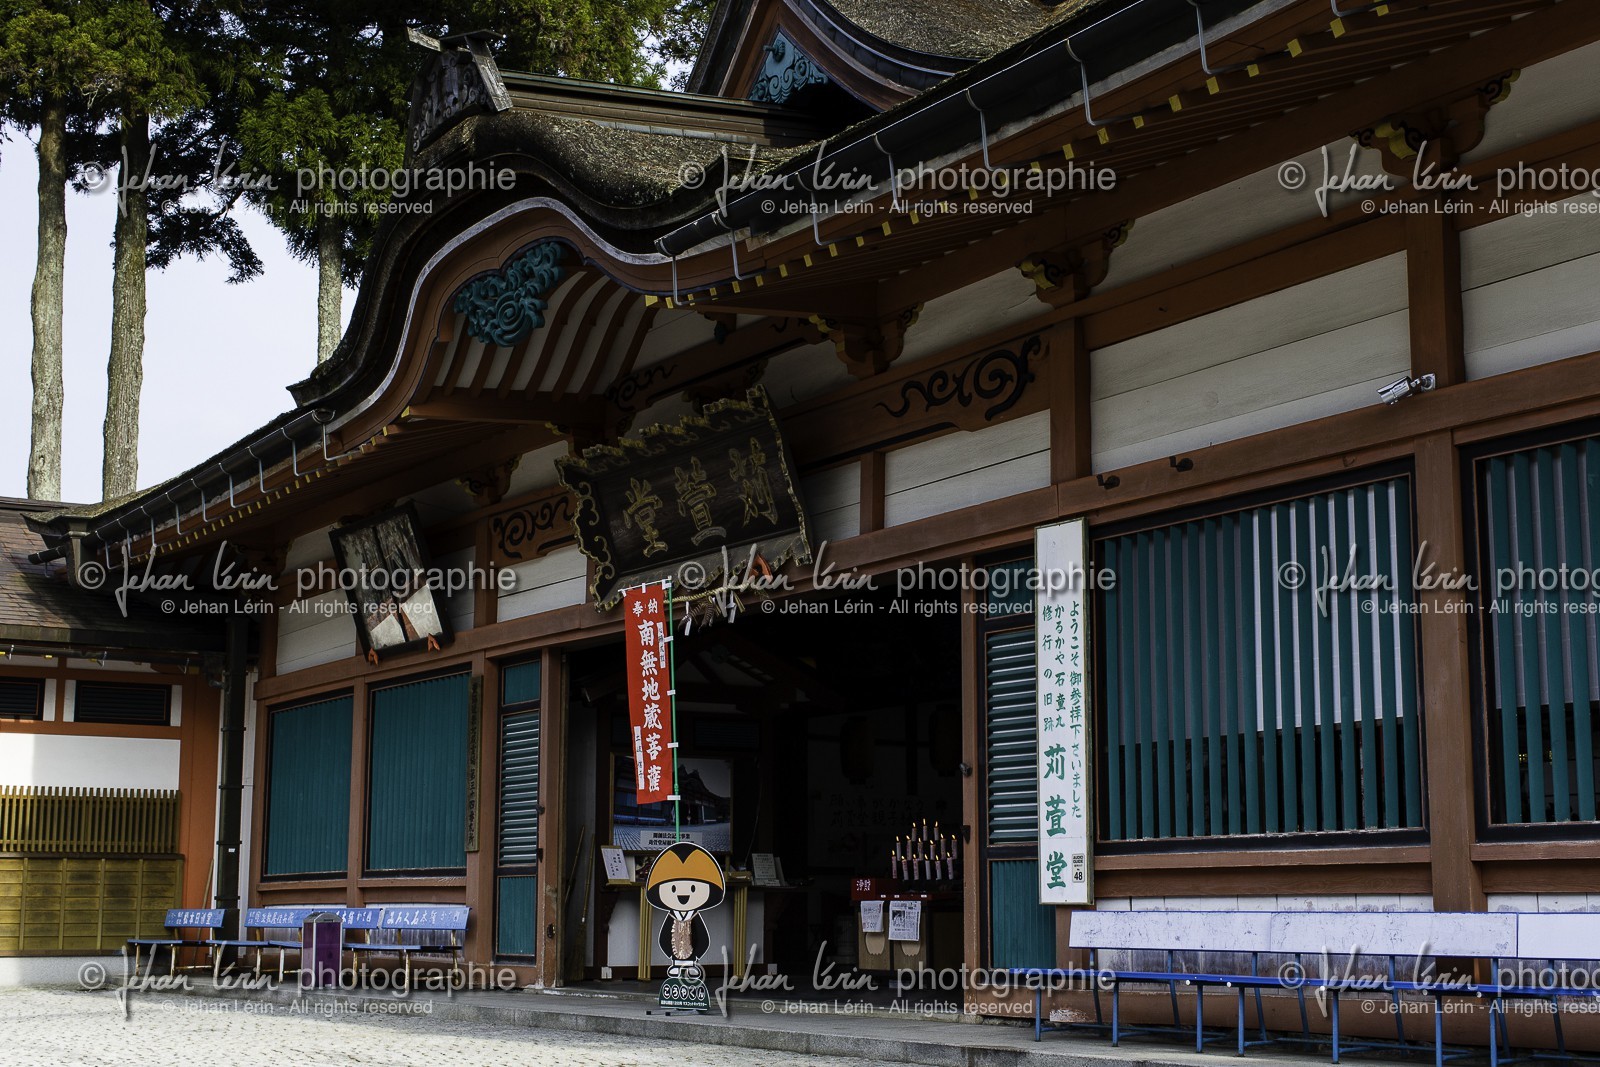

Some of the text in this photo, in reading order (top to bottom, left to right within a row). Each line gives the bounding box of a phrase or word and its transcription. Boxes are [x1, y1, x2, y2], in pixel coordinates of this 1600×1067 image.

[637, 619, 663, 792] 南無地蔵菩薩
[1042, 604, 1055, 733] 修行の旧跡
[1054, 603, 1066, 729] かるかや石童丸
[1043, 743, 1068, 890] 苅萱堂
[1074, 872, 1083, 880] 48
[663, 984, 706, 1001] こうやくん
